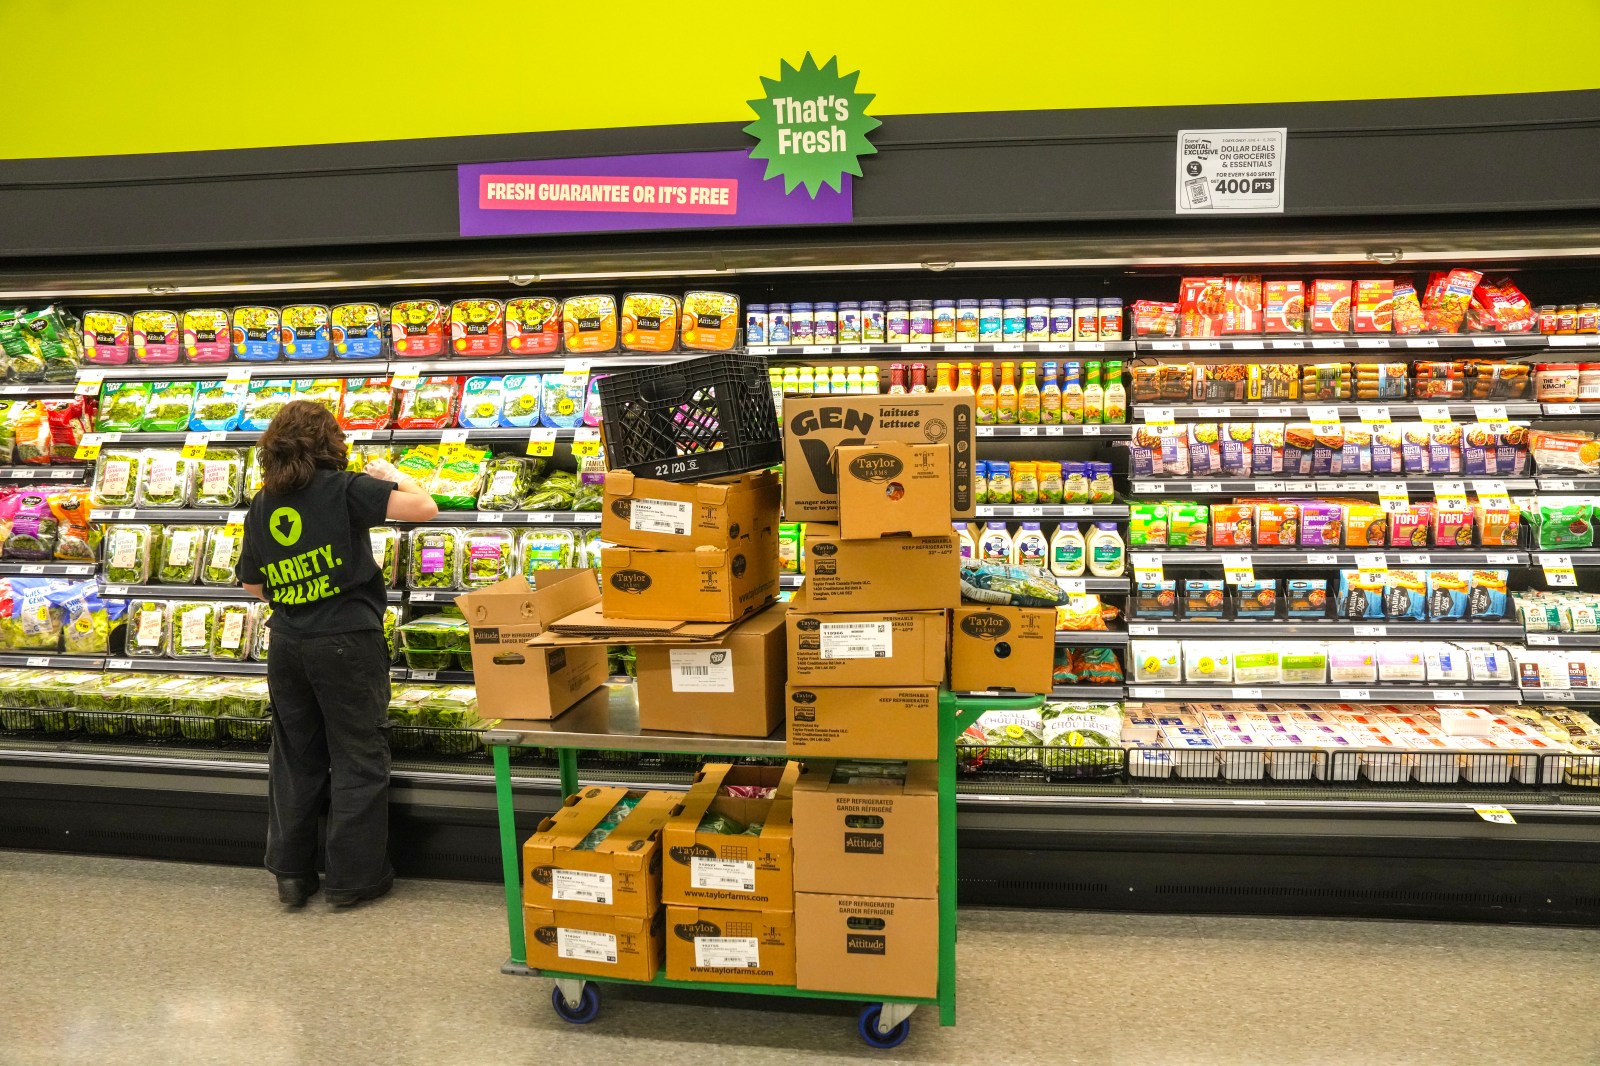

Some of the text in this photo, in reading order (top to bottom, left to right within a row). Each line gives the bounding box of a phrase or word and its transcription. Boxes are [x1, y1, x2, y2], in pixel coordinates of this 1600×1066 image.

[773, 95, 849, 124] That's
[779, 127, 846, 154] Fresh
[1215, 179, 1250, 194] 400
[487, 182, 729, 205] FRESH GUARANTEE OR IT'S FREE
[880, 408, 919, 417] laitues
[791, 407, 874, 436] GEN
[880, 420, 920, 428] lettuce
[857, 458, 895, 468] Taylor
[656, 464, 668, 476] 22
[1395, 515, 1418, 524] TOFU
[1440, 514, 1463, 524] TOFU
[1486, 514, 1509, 524] TOFU
[617, 573, 645, 583] Taylor
[273, 575, 340, 605] VALUE.
[969, 617, 1004, 628] Taylor
[1052, 721, 1080, 729] CHOU
[861, 805, 892, 813] RÉFRIGÉRÉ
[846, 837, 882, 848] Attitude
[685, 890, 768, 902] www.taylorfarms.com
[863, 907, 894, 915] RÉFRIGÉRÉ
[849, 939, 884, 949] Attitude
[690, 966, 774, 977] www.taylorfarms.com
